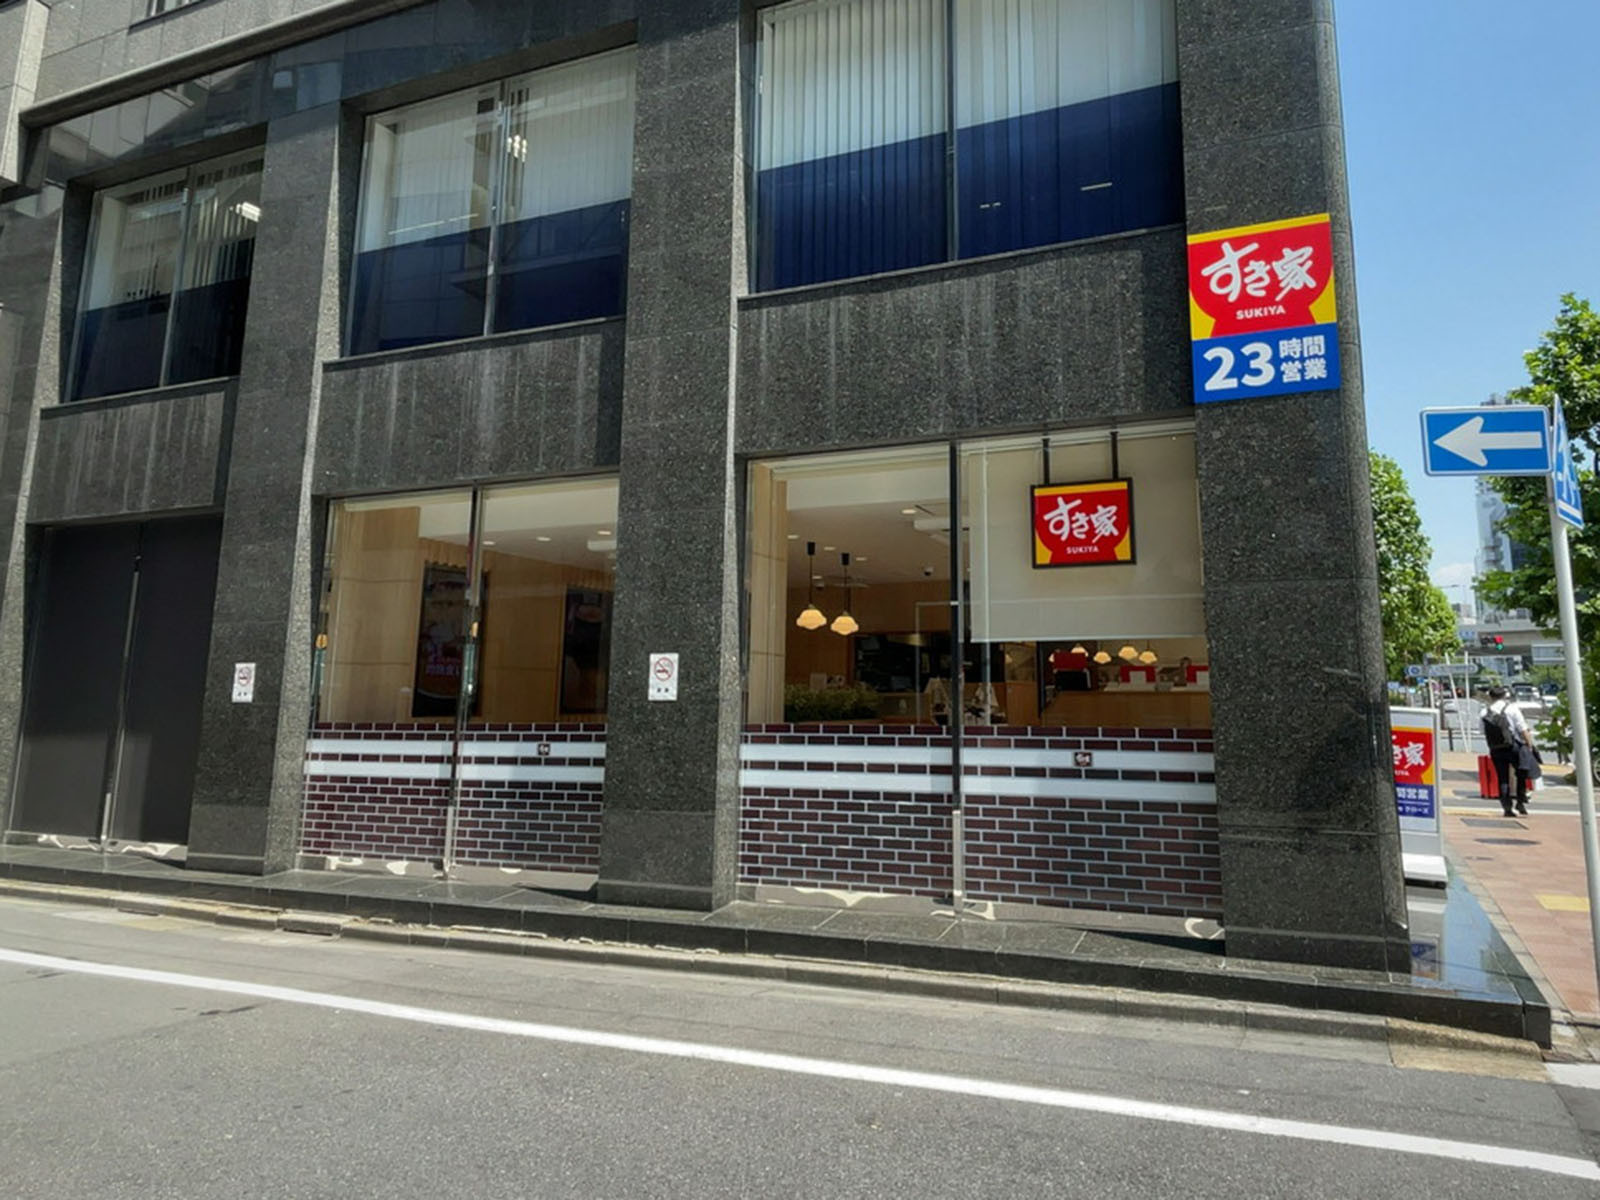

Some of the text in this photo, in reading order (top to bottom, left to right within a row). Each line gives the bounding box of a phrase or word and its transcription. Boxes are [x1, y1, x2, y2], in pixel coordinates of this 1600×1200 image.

[1201, 241, 1317, 303] すき家
[1236, 305, 1286, 320] SUKIYA
[1203, 335, 1325, 391] 23 時間
[1280, 357, 1328, 383] 営業
[1043, 496, 1119, 543] すき家
[1066, 545, 1099, 554] SUKIYA
[1392, 735, 1425, 769] き家
